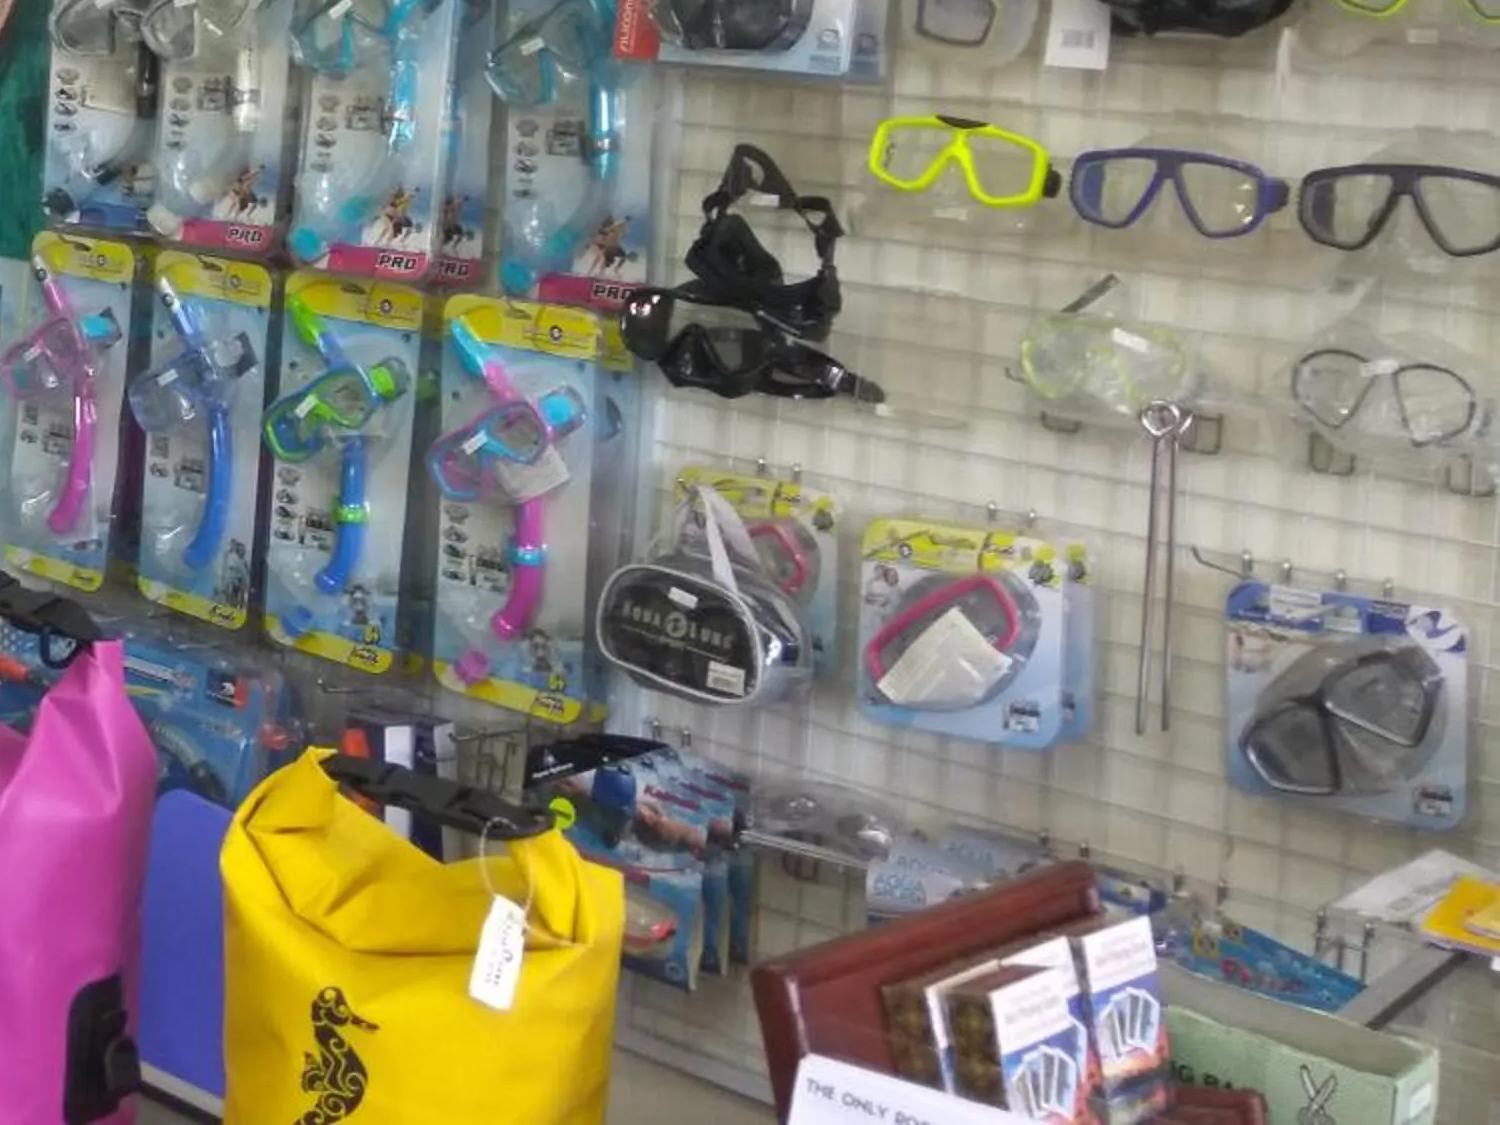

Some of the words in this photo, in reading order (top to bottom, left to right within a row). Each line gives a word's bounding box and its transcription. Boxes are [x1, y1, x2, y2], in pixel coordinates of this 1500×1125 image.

[379, 254, 418, 271] PRO
[806, 1078, 836, 1100] THE
[841, 1092, 889, 1119] ONLY
